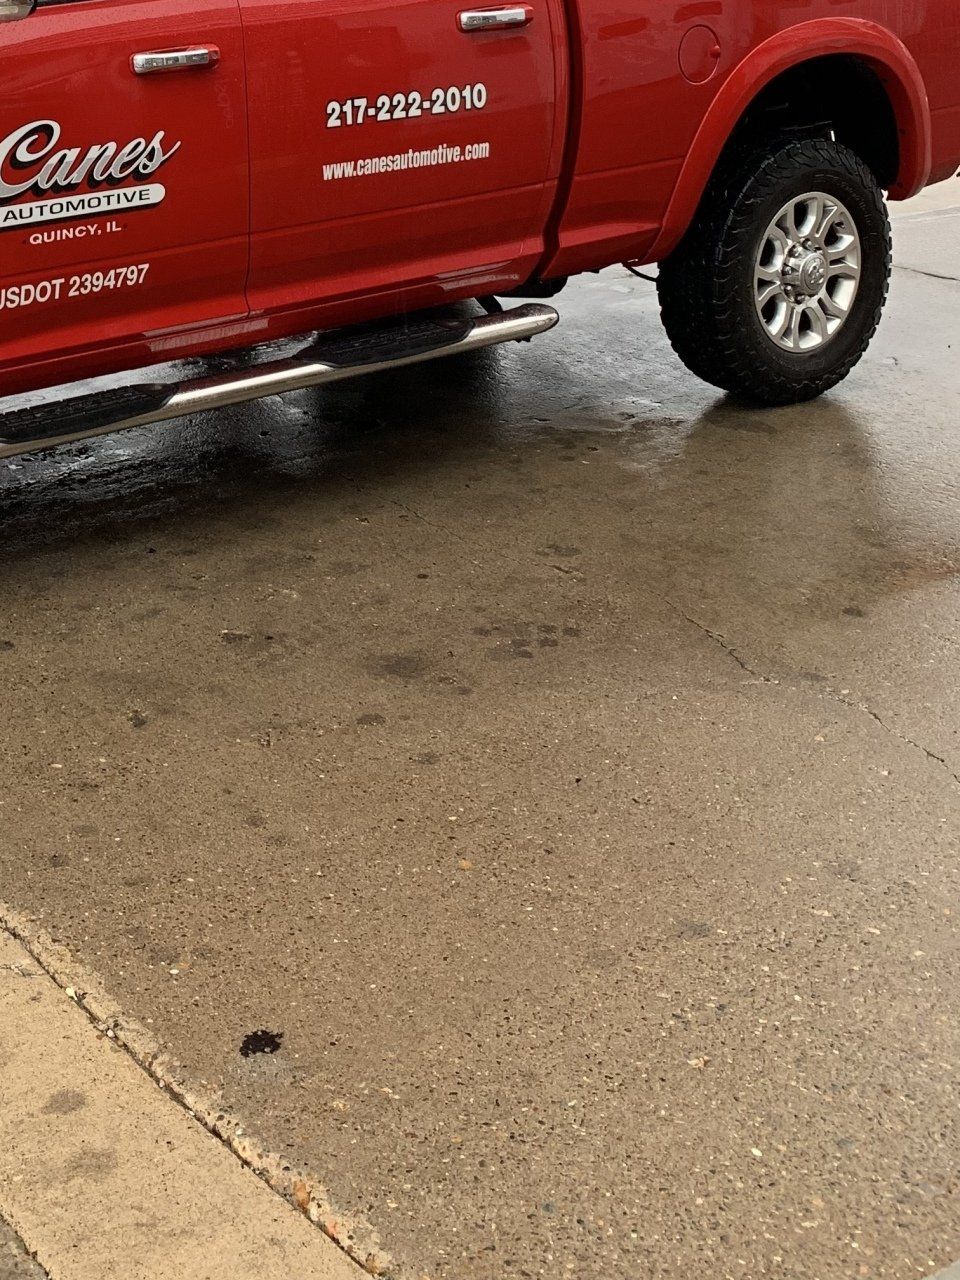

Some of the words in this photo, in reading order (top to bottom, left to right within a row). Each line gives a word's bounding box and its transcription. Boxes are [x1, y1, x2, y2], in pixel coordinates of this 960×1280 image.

[326, 82, 488, 128] 217-222-2010
[322, 142, 489, 181] www.canesautomotive.com
[3, 188, 151, 222] AUTOMOTIVE
[29, 224, 102, 245] QUINCY,
[106, 221, 122, 233] IL
[68, 263, 150, 297] 2394797
